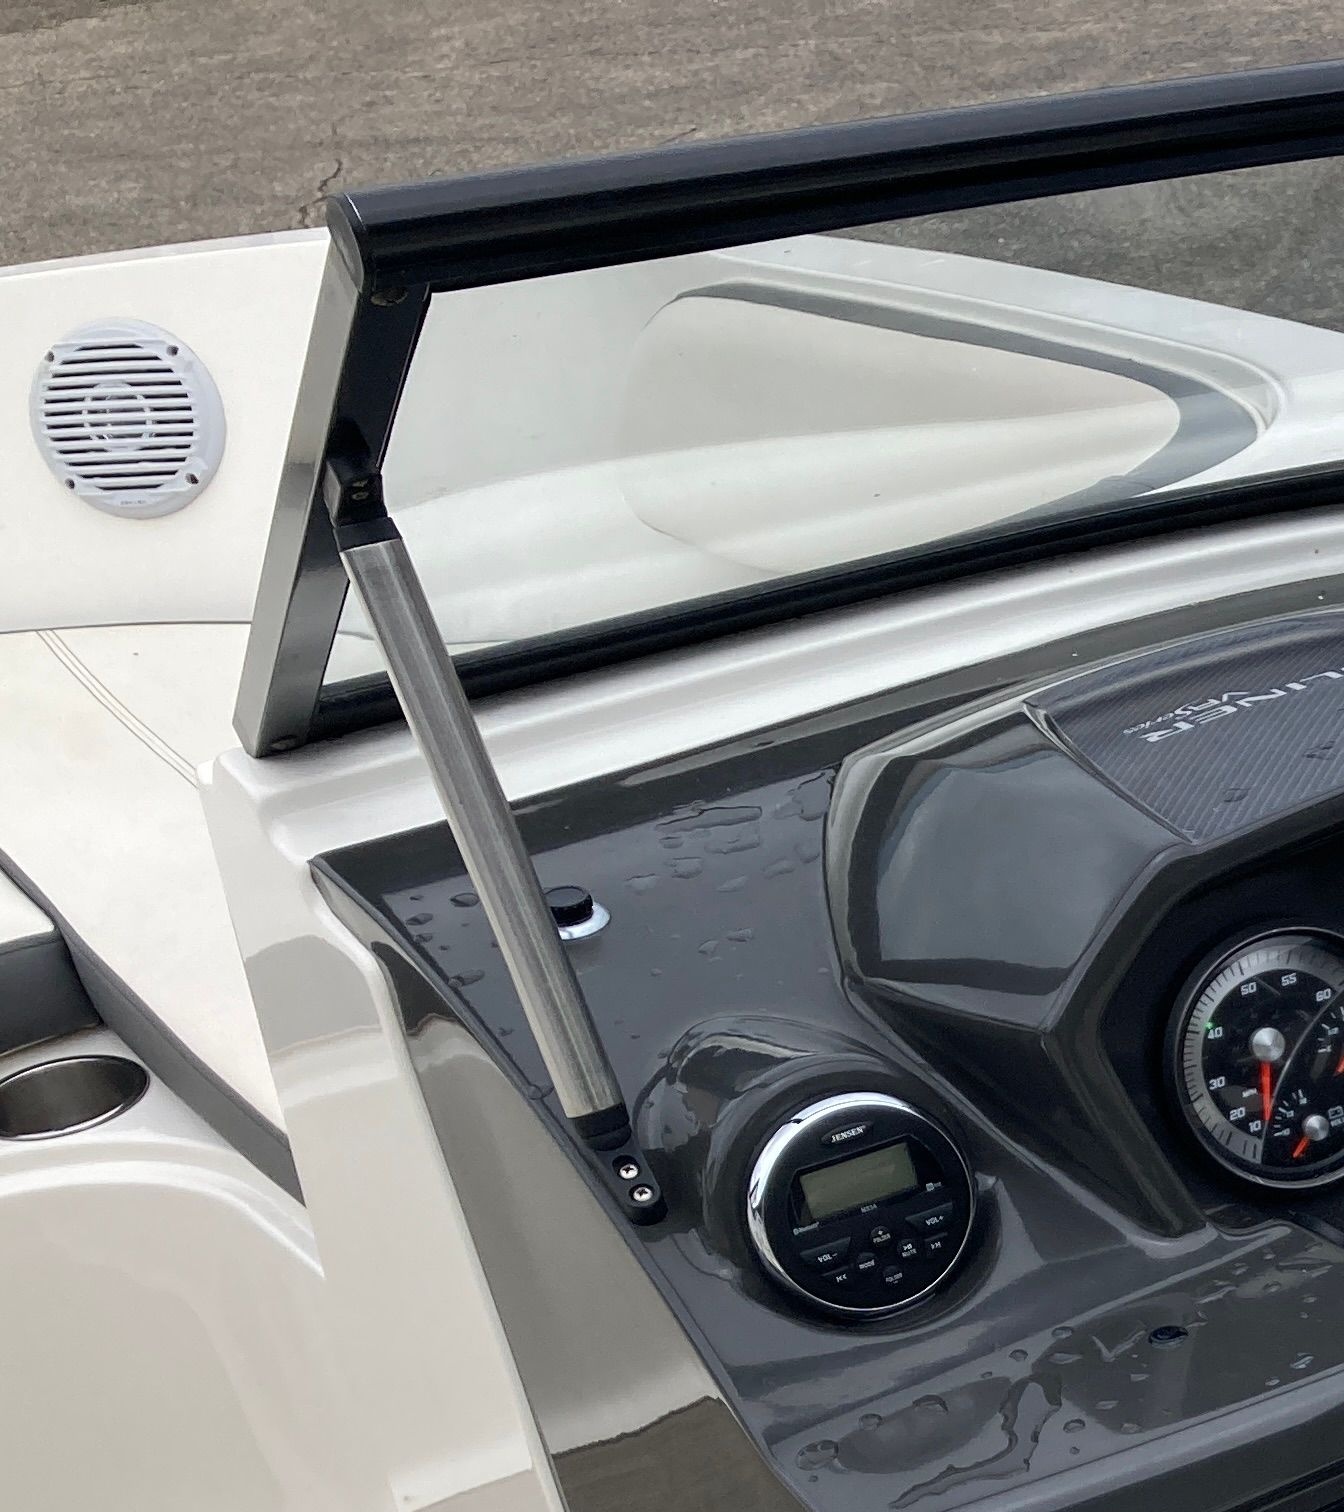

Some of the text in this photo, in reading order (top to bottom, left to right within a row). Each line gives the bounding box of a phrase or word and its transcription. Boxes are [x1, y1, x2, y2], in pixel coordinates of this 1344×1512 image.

[1281, 973, 1297, 986] 55
[1241, 982, 1257, 996] 50
[1315, 988, 1332, 1002] 60
[1208, 1027, 1223, 1040] 40
[1209, 1076, 1226, 1090] 30
[1230, 1107, 1246, 1121] 20
[1248, 1121, 1262, 1133] 10
[831, 1126, 865, 1143] JENSEN
